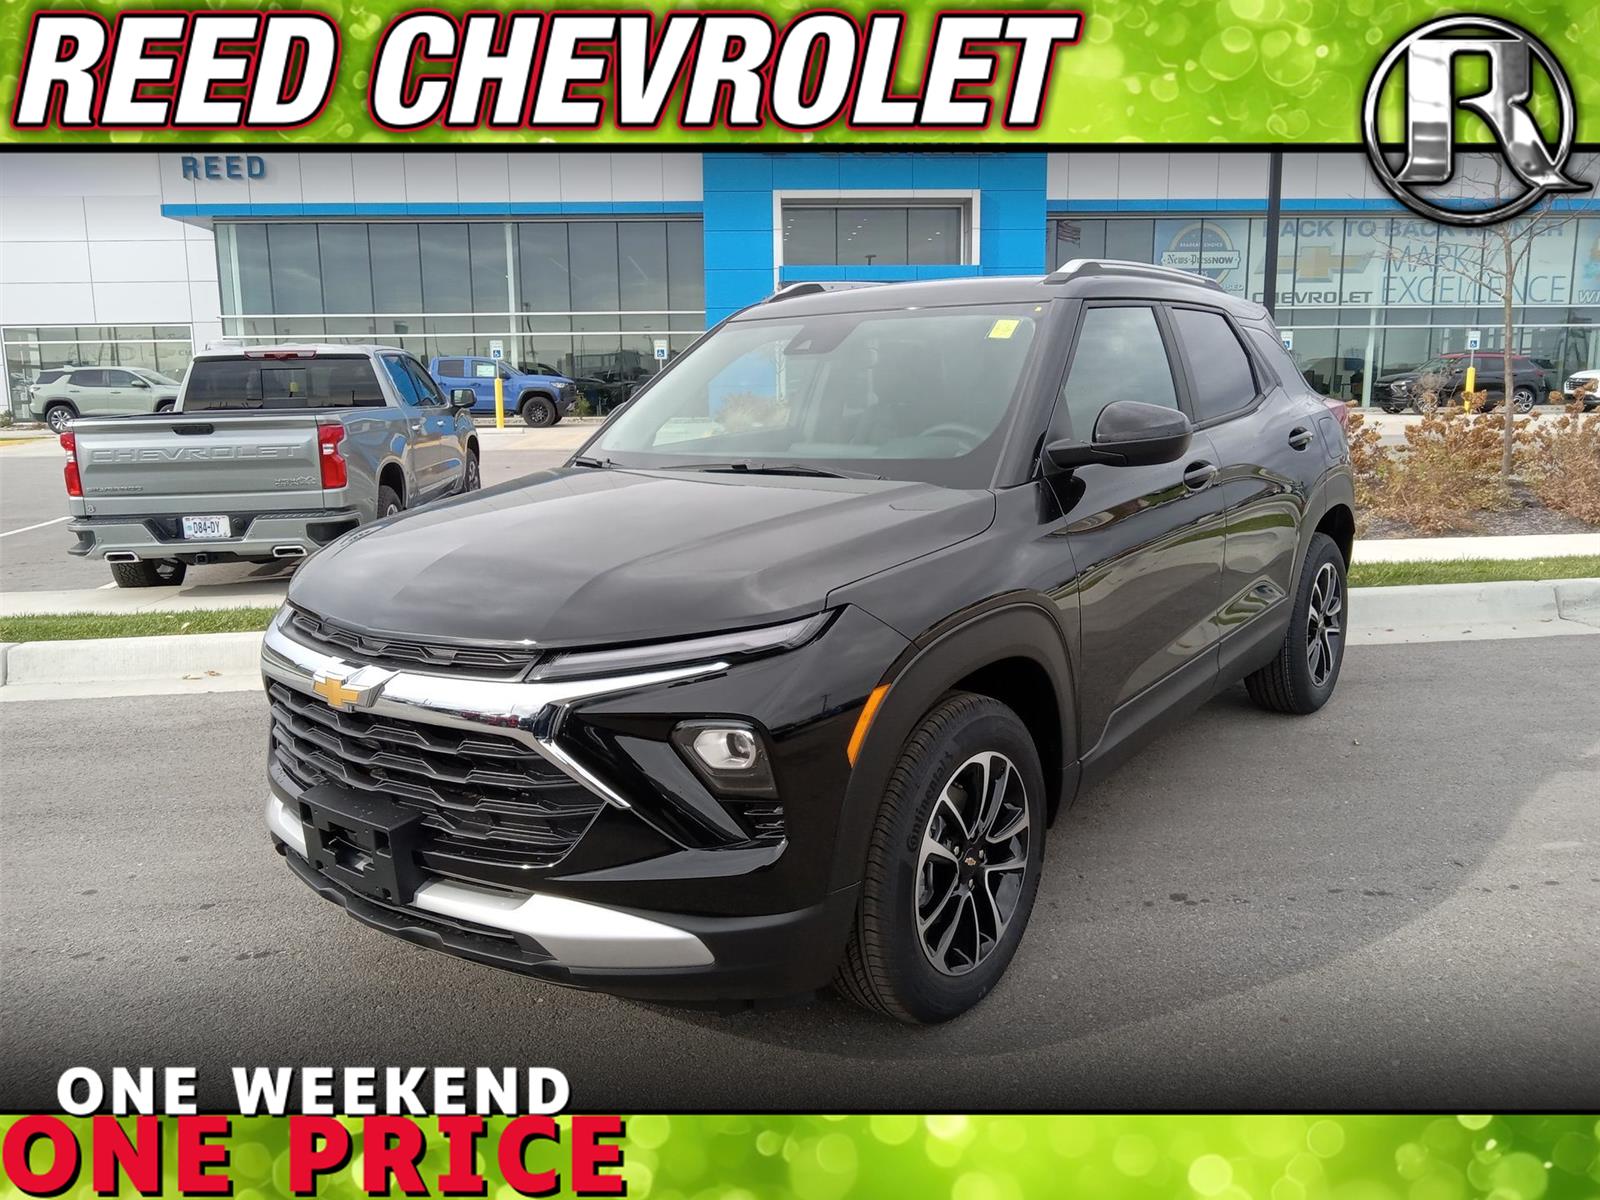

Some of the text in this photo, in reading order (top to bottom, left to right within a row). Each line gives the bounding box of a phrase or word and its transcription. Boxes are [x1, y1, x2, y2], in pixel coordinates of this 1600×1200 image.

[181, 155, 265, 178] REED
[1262, 220, 1334, 237] ACK
[1346, 220, 1377, 238] TO
[1384, 220, 1455, 238] BACK
[1383, 244, 1470, 273] MARK
[1252, 291, 1373, 304] CEVROLET
[1382, 275, 1567, 304] EXCELLENCE
[92, 444, 302, 463] CHEVROLET
